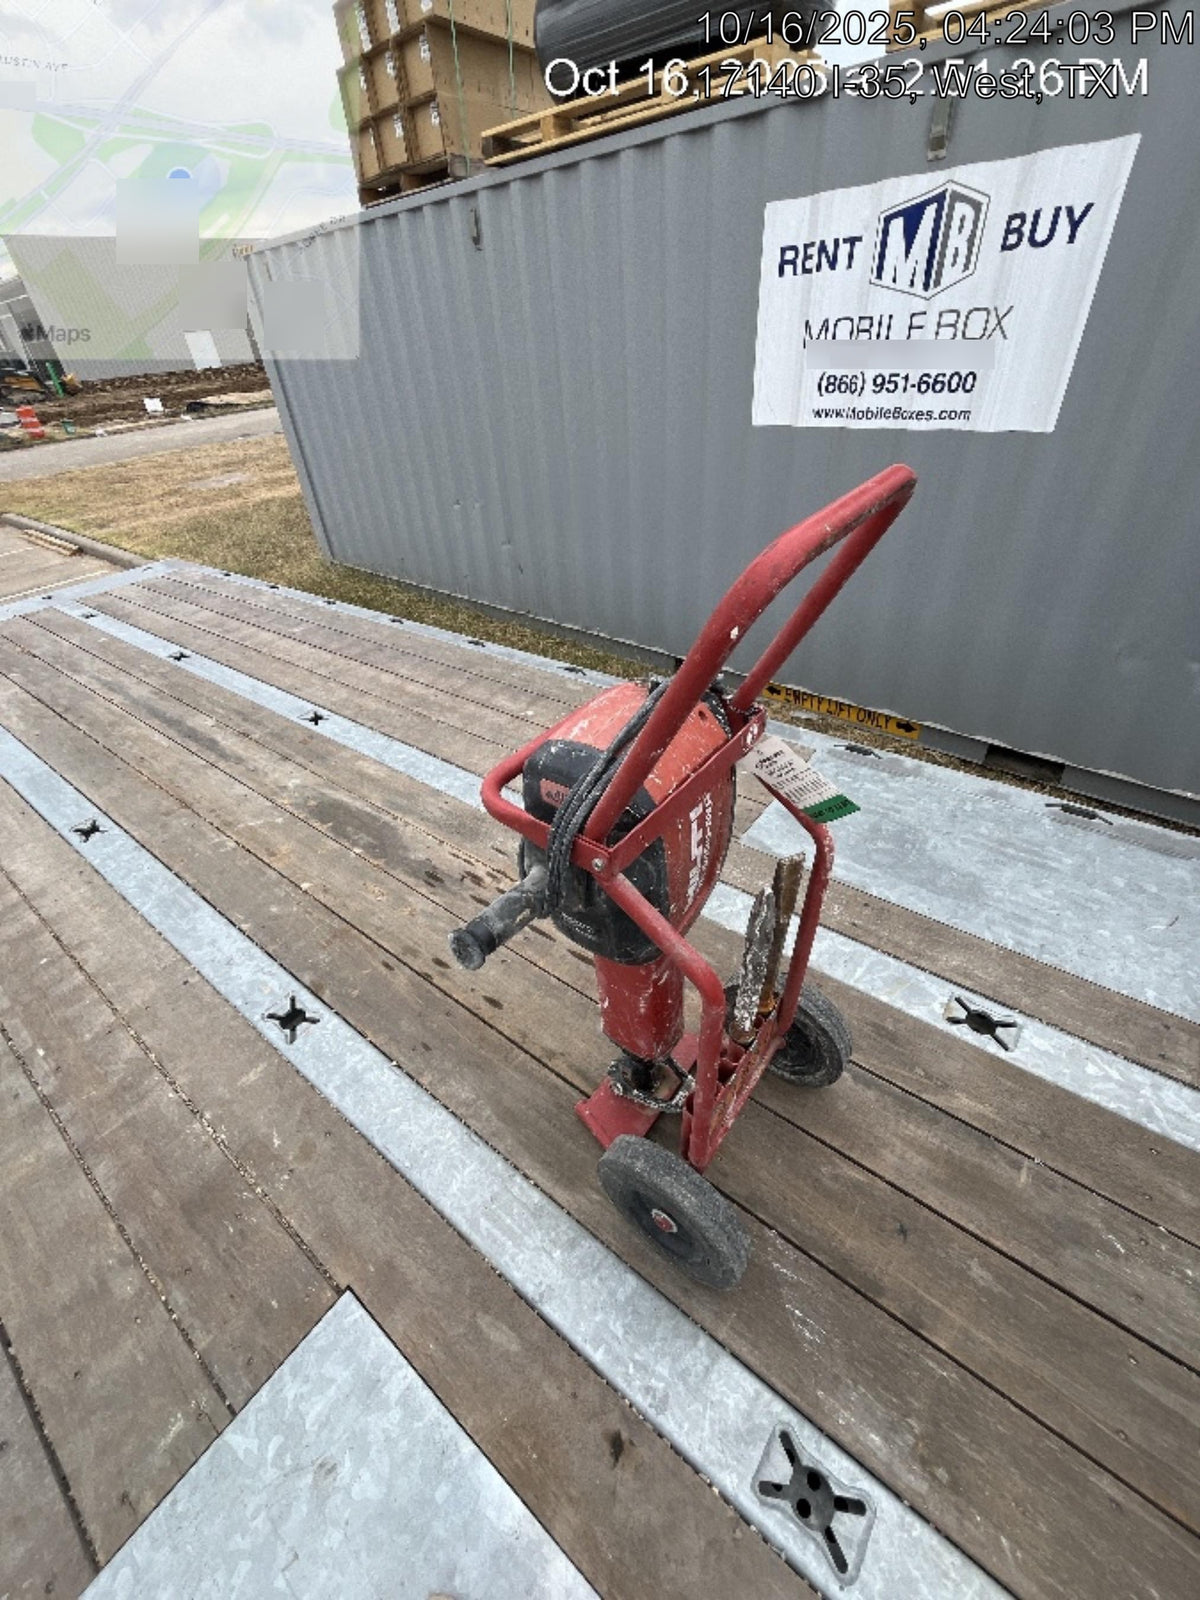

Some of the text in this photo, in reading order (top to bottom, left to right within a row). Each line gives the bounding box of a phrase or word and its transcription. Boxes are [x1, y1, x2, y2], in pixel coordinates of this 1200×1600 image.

[778, 236, 862, 277] RENT
[1001, 202, 1096, 252] BUY
[934, 305, 1014, 340] BOX
[817, 371, 977, 397] (866) 951-6600
[784, 687, 892, 730] EMPTY LIFT ONLY
